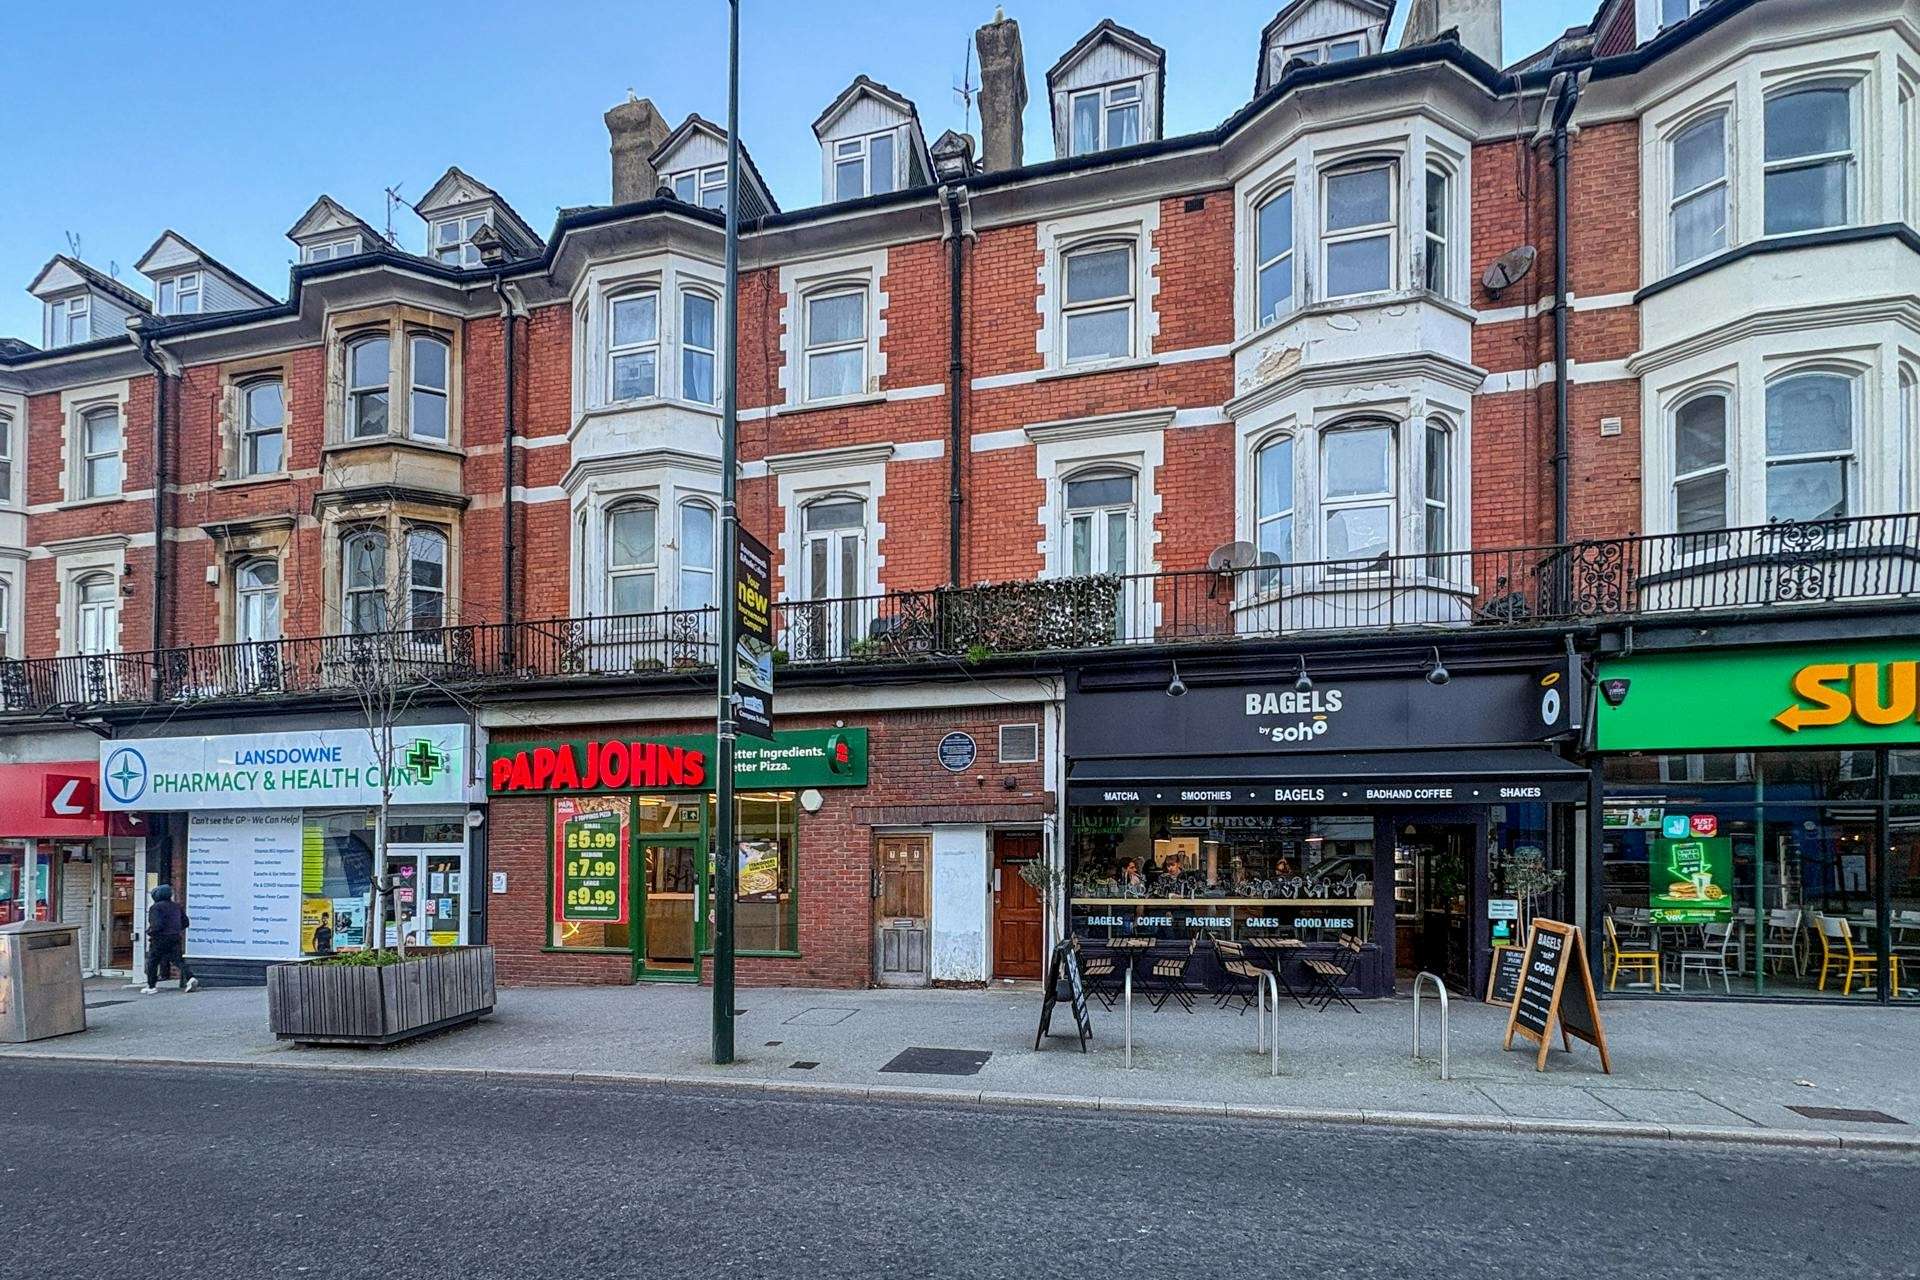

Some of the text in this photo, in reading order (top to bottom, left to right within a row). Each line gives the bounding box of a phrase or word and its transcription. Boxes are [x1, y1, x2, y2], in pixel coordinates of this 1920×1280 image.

[738, 581, 768, 614] new
[1245, 689, 1343, 715] BAGELS
[1775, 661, 1920, 732] SU
[1259, 720, 1328, 742] by soho
[234, 746, 342, 766] LANSDOWNE
[759, 746, 826, 760] Ingredients.
[491, 739, 706, 791] PAPA JOHNS
[759, 761, 792, 772] Pizza.
[153, 770, 259, 793] PHARMACY
[263, 770, 276, 791] &
[281, 768, 359, 790] HEALTH
[1104, 787, 1542, 801] MATCHA SMOOTHIES BAGELS BADHAND COFFEE SHAKES
[191, 815, 210, 825] Can't
[210, 816, 222, 825] see
[222, 815, 234, 825] the
[235, 815, 247, 825] GP
[252, 815, 264, 824] We
[265, 815, 279, 824] Can
[280, 814, 300, 826] Help!
[660, 801, 679, 828] 7
[1693, 818, 1714, 826] JUST
[568, 830, 616, 849] £5.99
[568, 859, 616, 877] £7.99
[568, 887, 616, 905] £9.99
[1088, 916, 1354, 928] BAGELS COFFEE PASTRIES CAKES GOOD VIBES
[1537, 933, 1562, 951] BAGELS
[1534, 961, 1555, 977] OPEN
